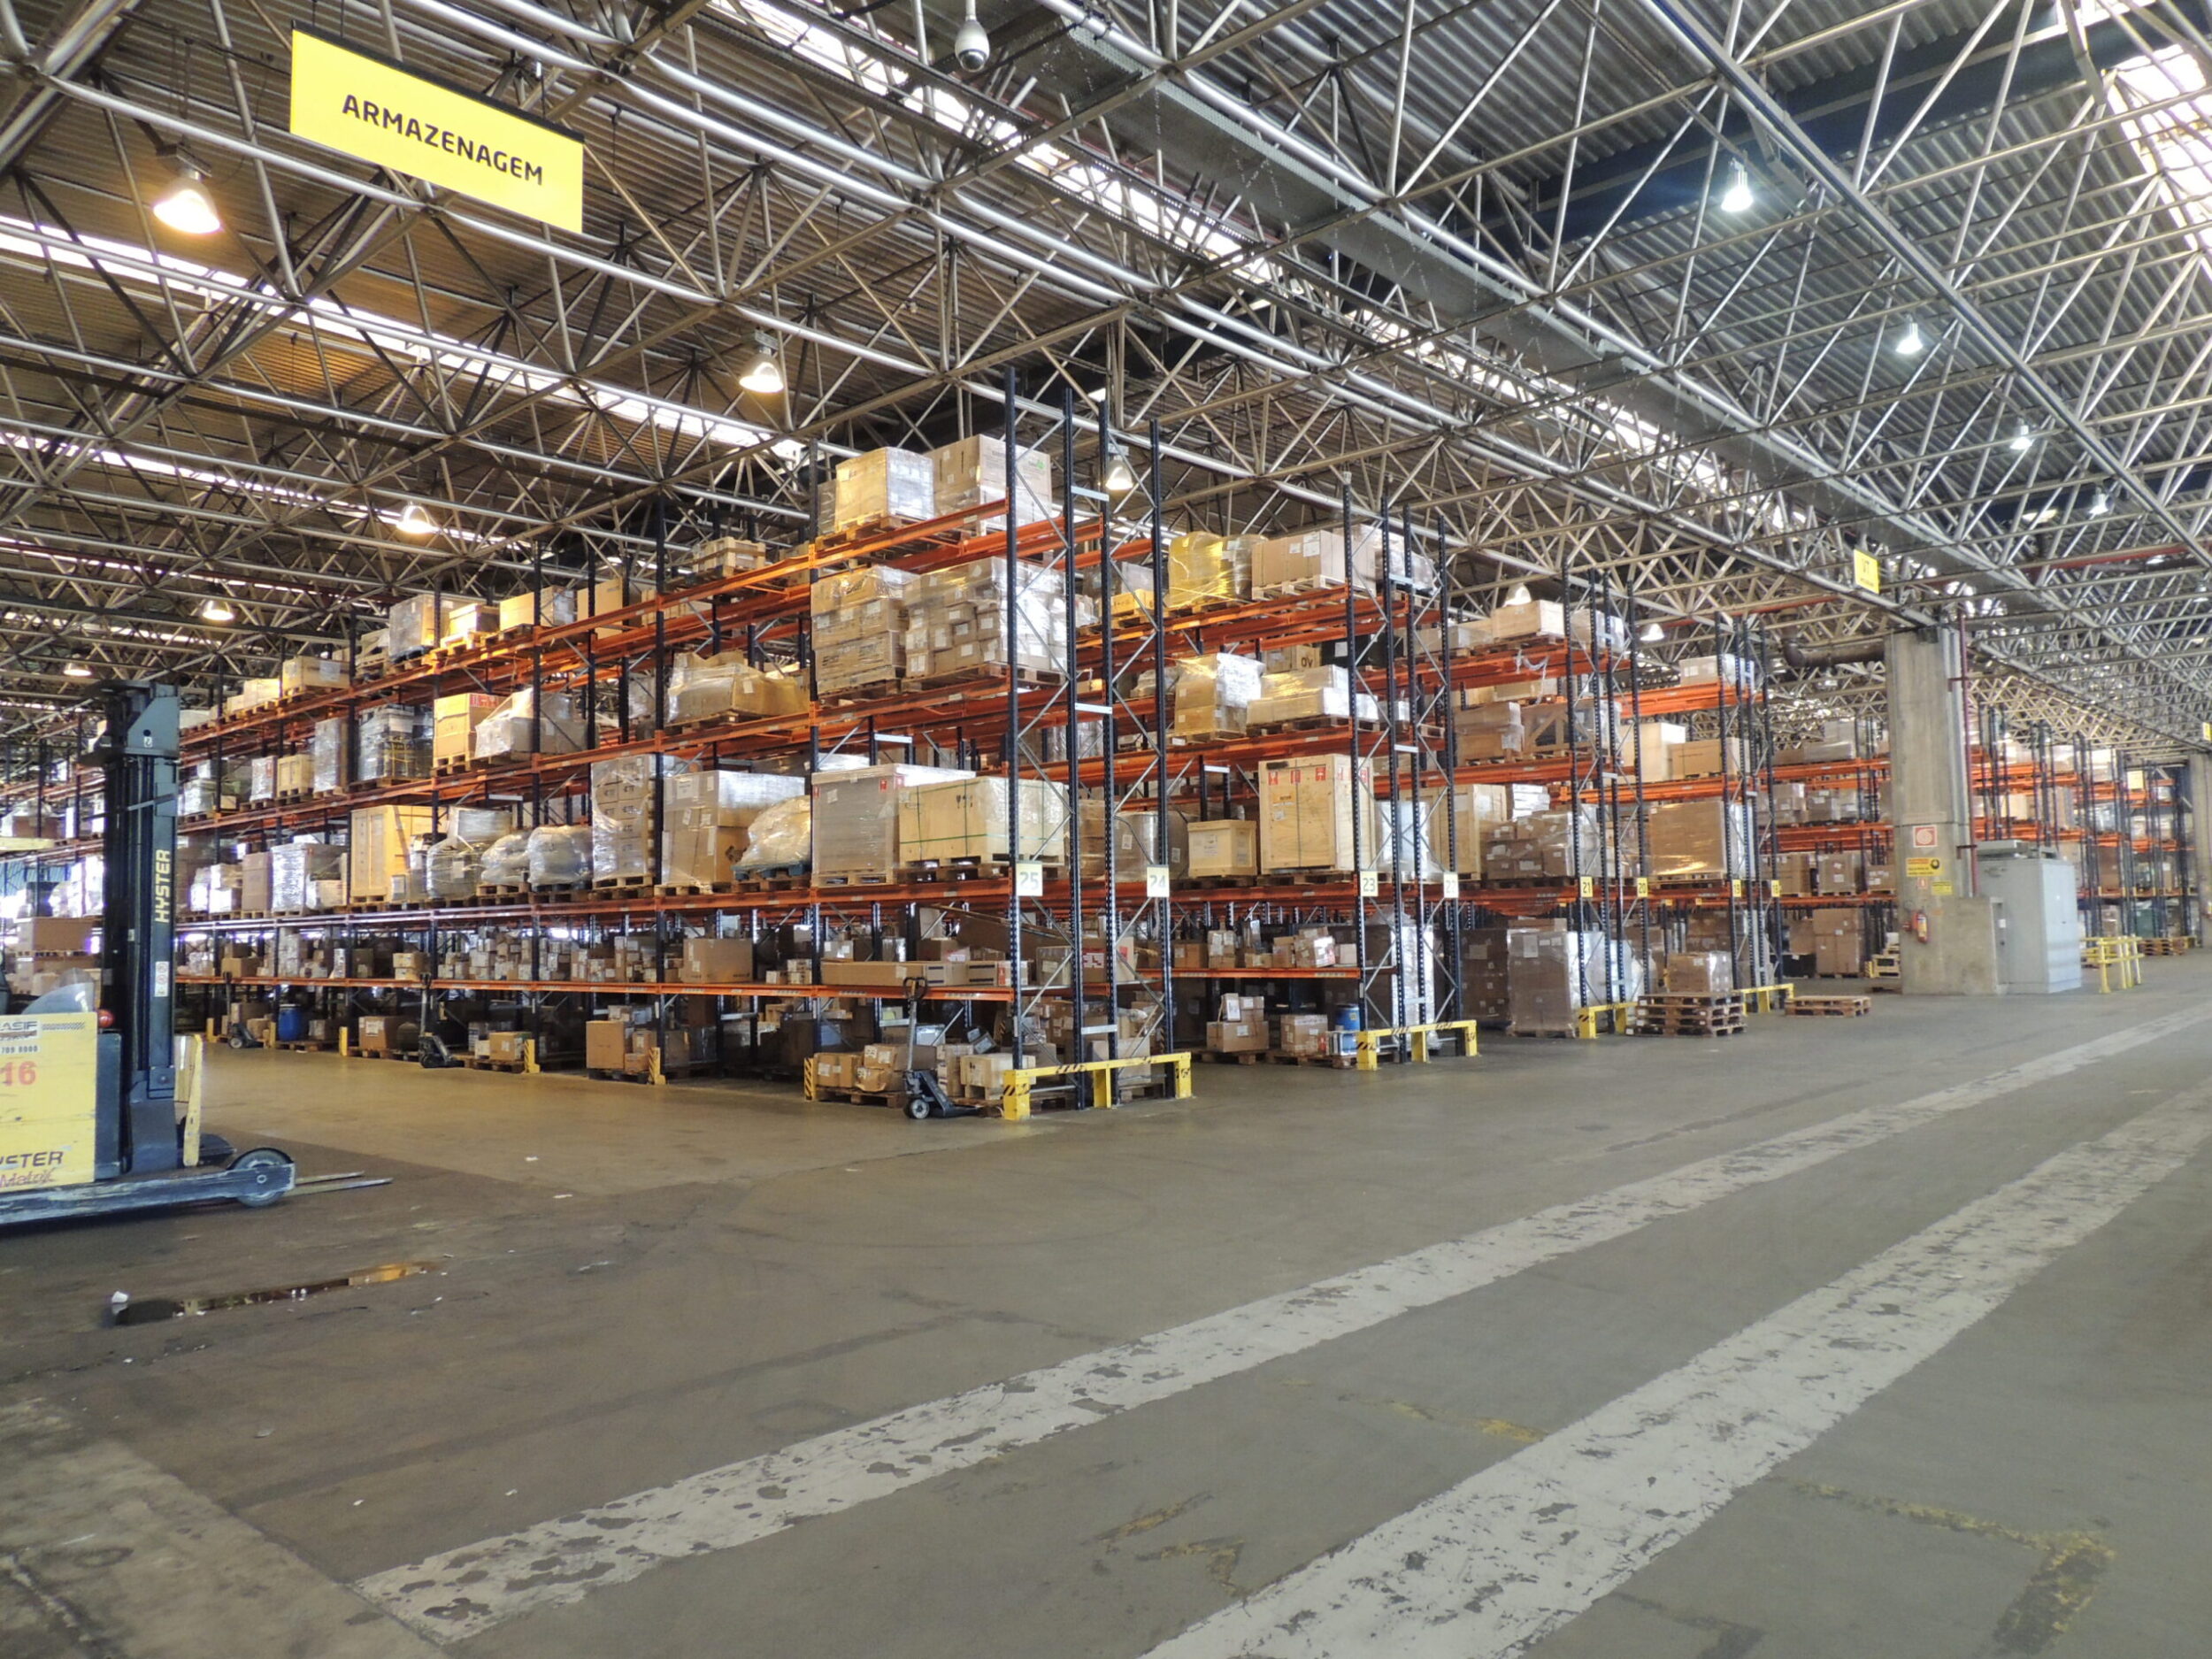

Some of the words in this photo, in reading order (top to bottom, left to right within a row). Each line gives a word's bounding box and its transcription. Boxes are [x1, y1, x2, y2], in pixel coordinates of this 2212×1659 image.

[342, 94, 542, 186] ARMAZENAGEM
[155, 849, 171, 923] HYSTER
[1019, 872, 1040, 890] 25
[1149, 874, 1166, 889] 24
[1363, 877, 1376, 893] 23
[1582, 881, 1591, 894] 21
[0, 1020, 37, 1031] ASIF
[0, 1061, 36, 1087] 16
